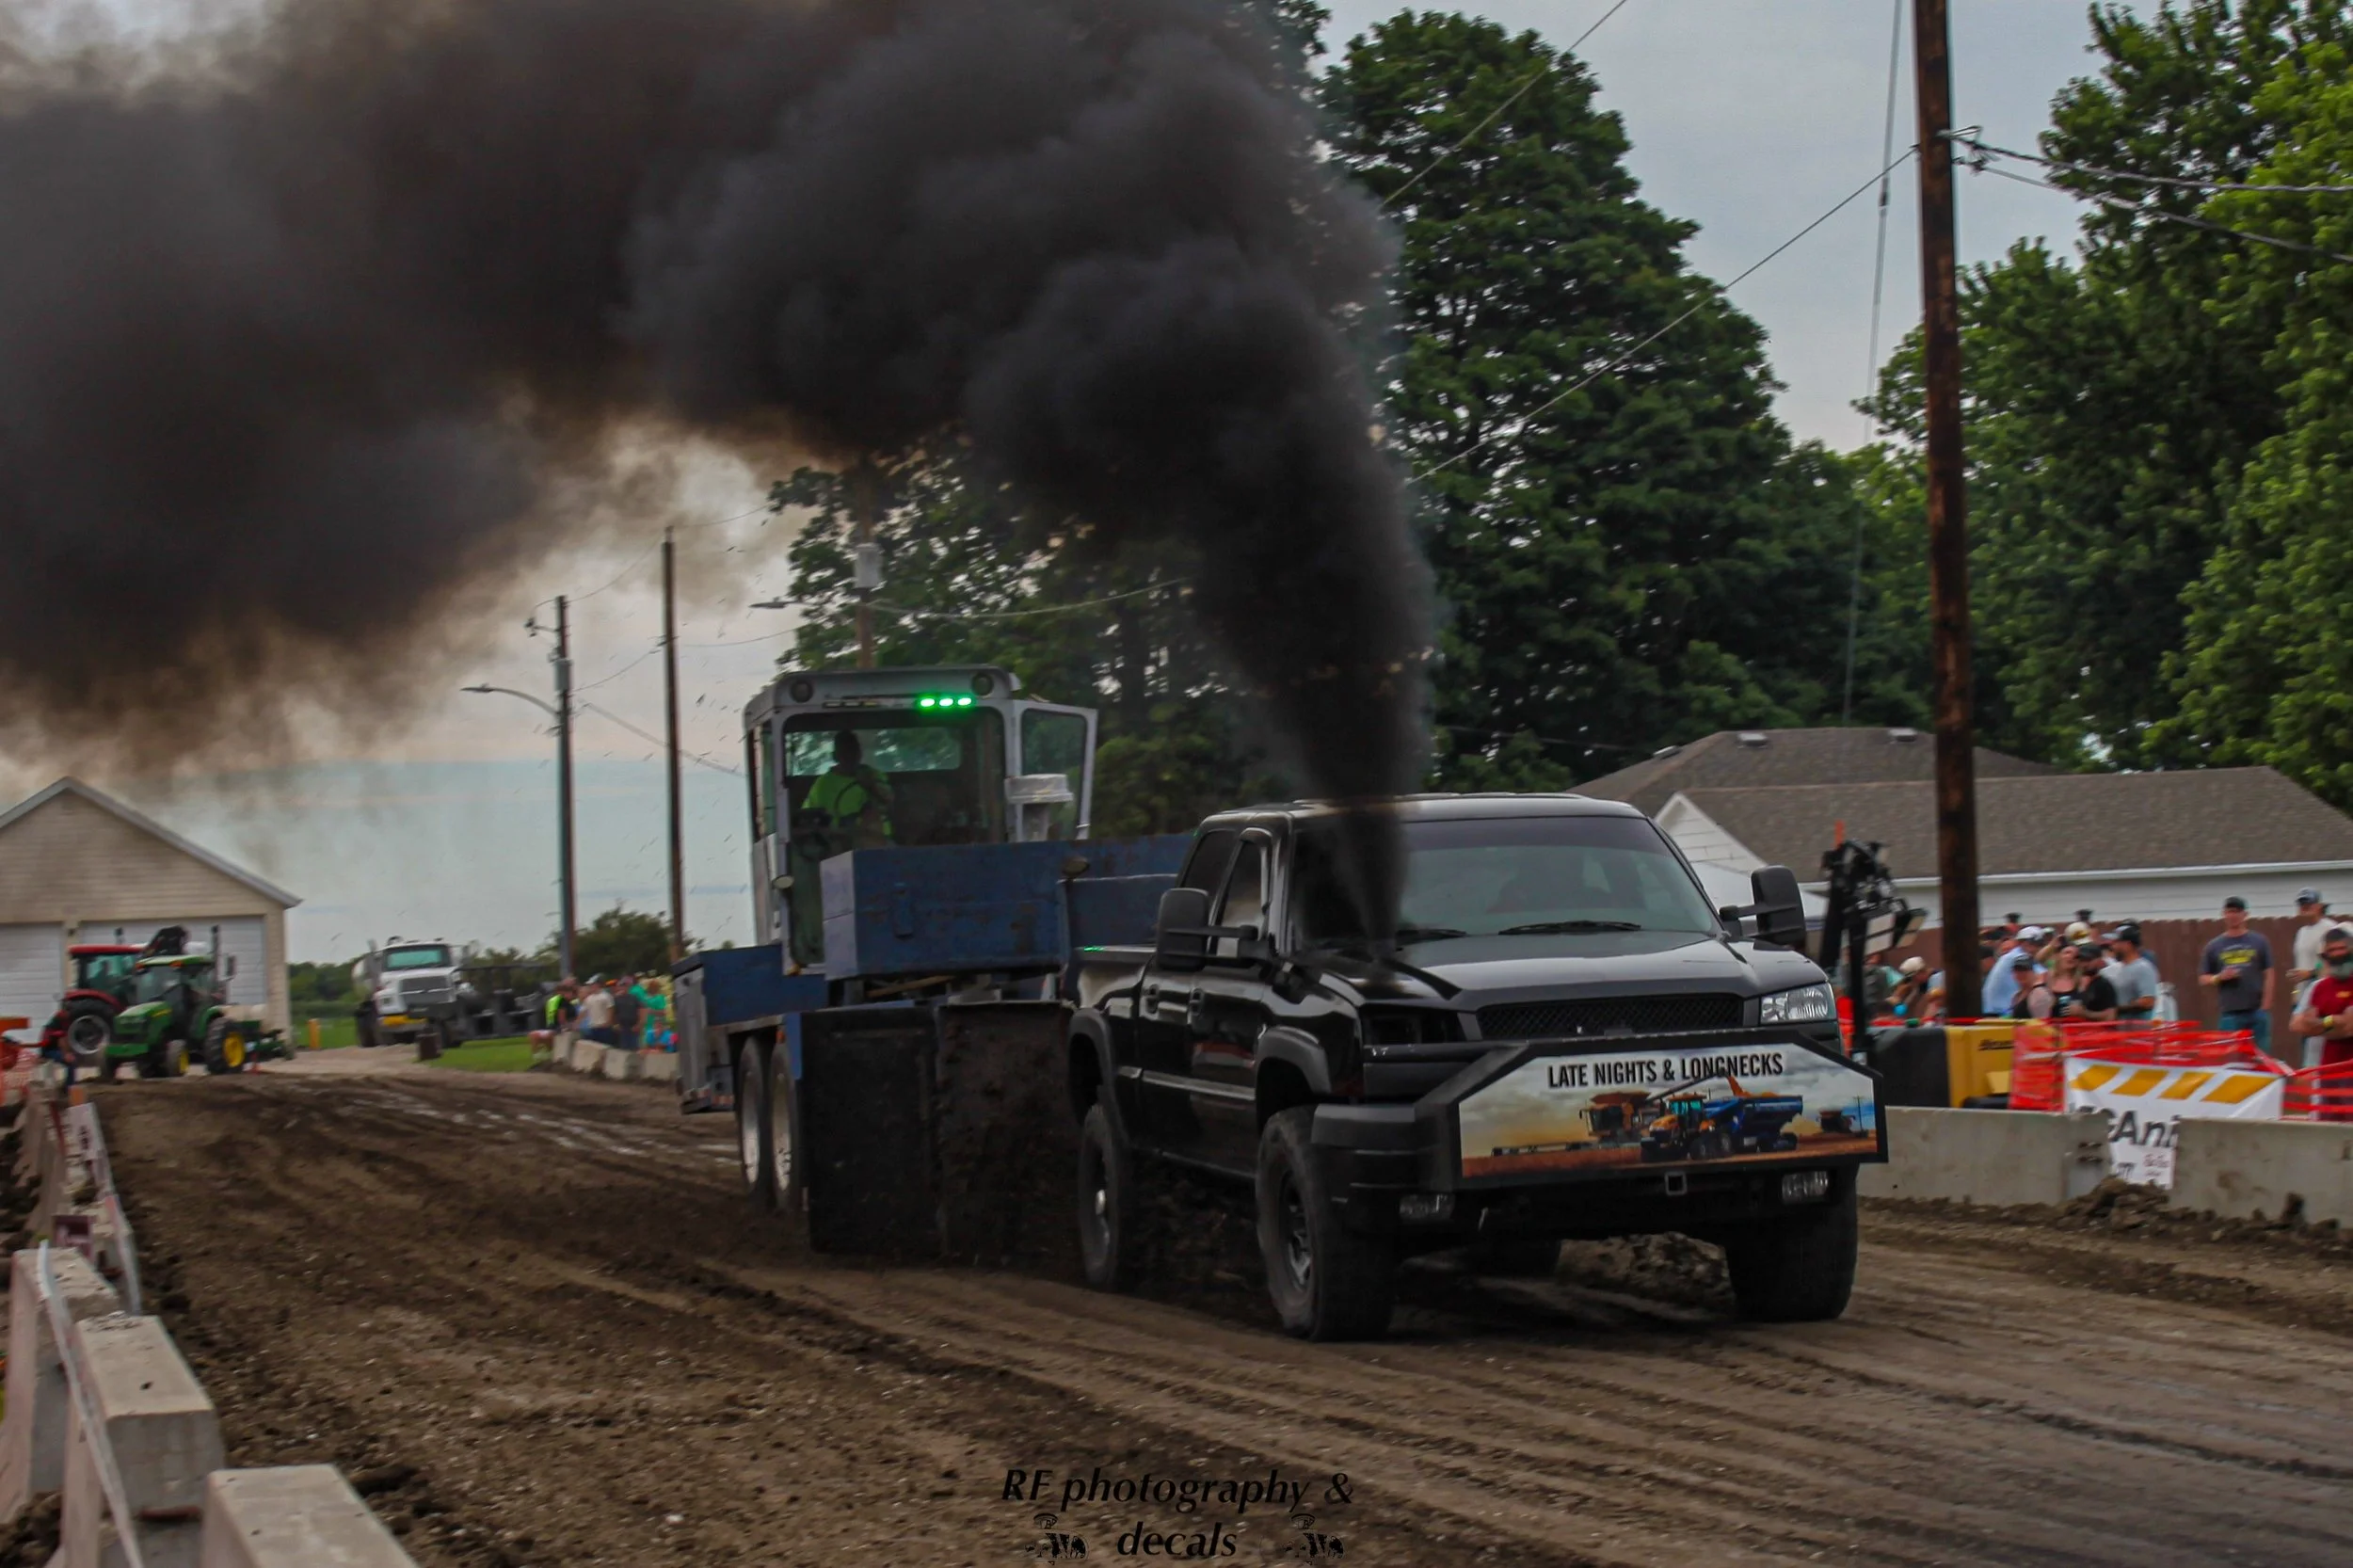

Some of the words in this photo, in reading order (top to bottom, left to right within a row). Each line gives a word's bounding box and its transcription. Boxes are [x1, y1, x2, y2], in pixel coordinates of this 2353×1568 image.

[1548, 1064, 1588, 1089] LATE
[1594, 1060, 1657, 1085] NIGHTS
[1663, 1058, 1675, 1081] &
[1681, 1052, 1783, 1080] LONGNECKS
